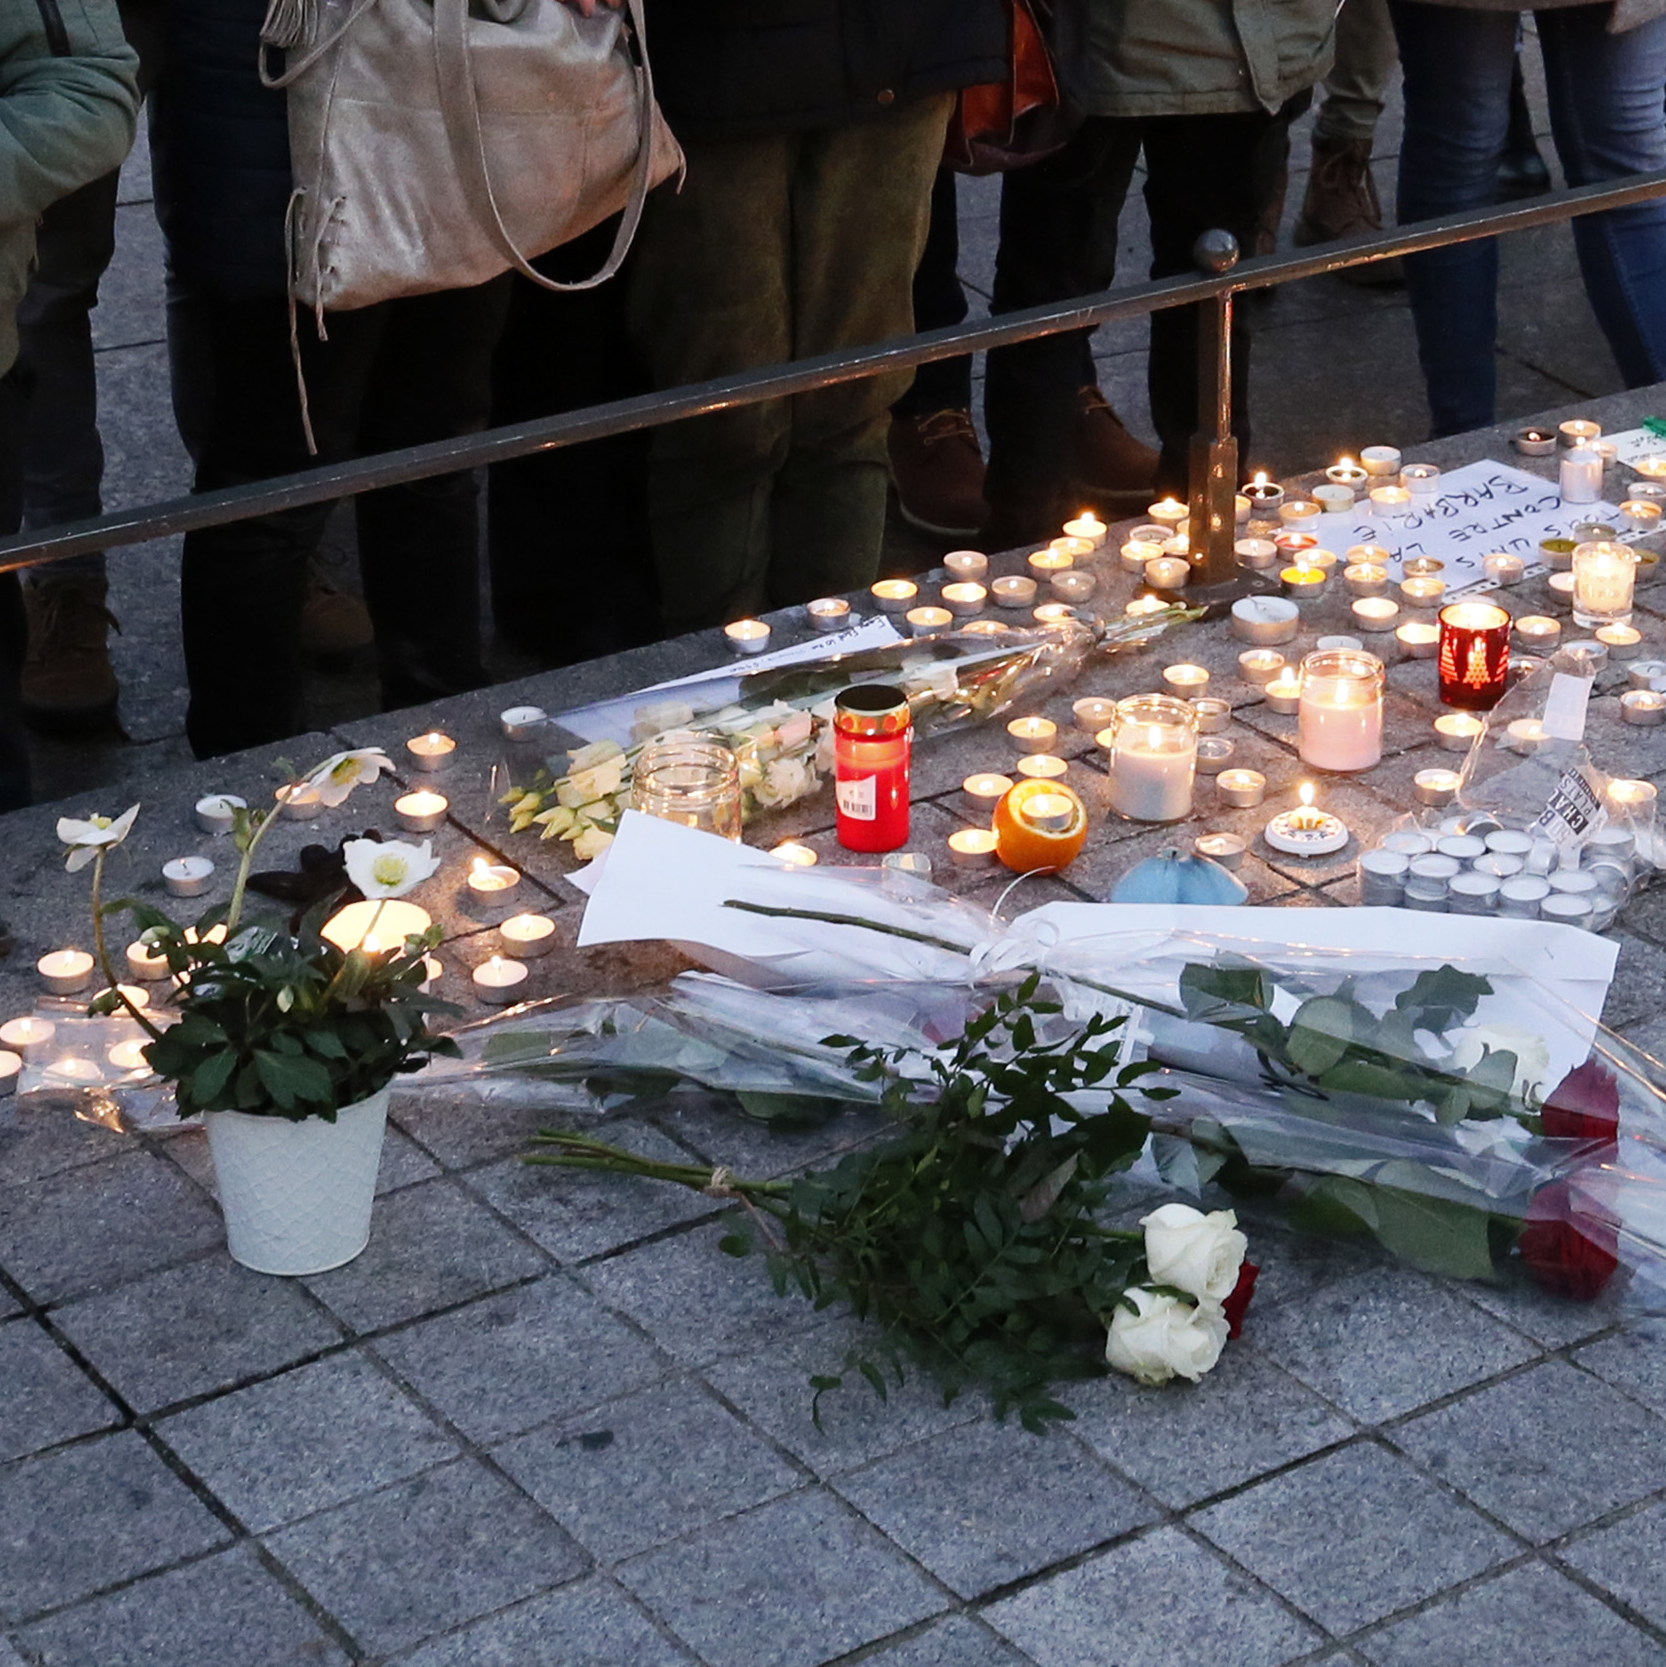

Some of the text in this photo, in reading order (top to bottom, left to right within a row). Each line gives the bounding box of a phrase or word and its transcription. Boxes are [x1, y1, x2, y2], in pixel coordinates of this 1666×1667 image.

[1389, 495, 1562, 563] CONTRE LA
[1560, 777, 1593, 816] PLATS
